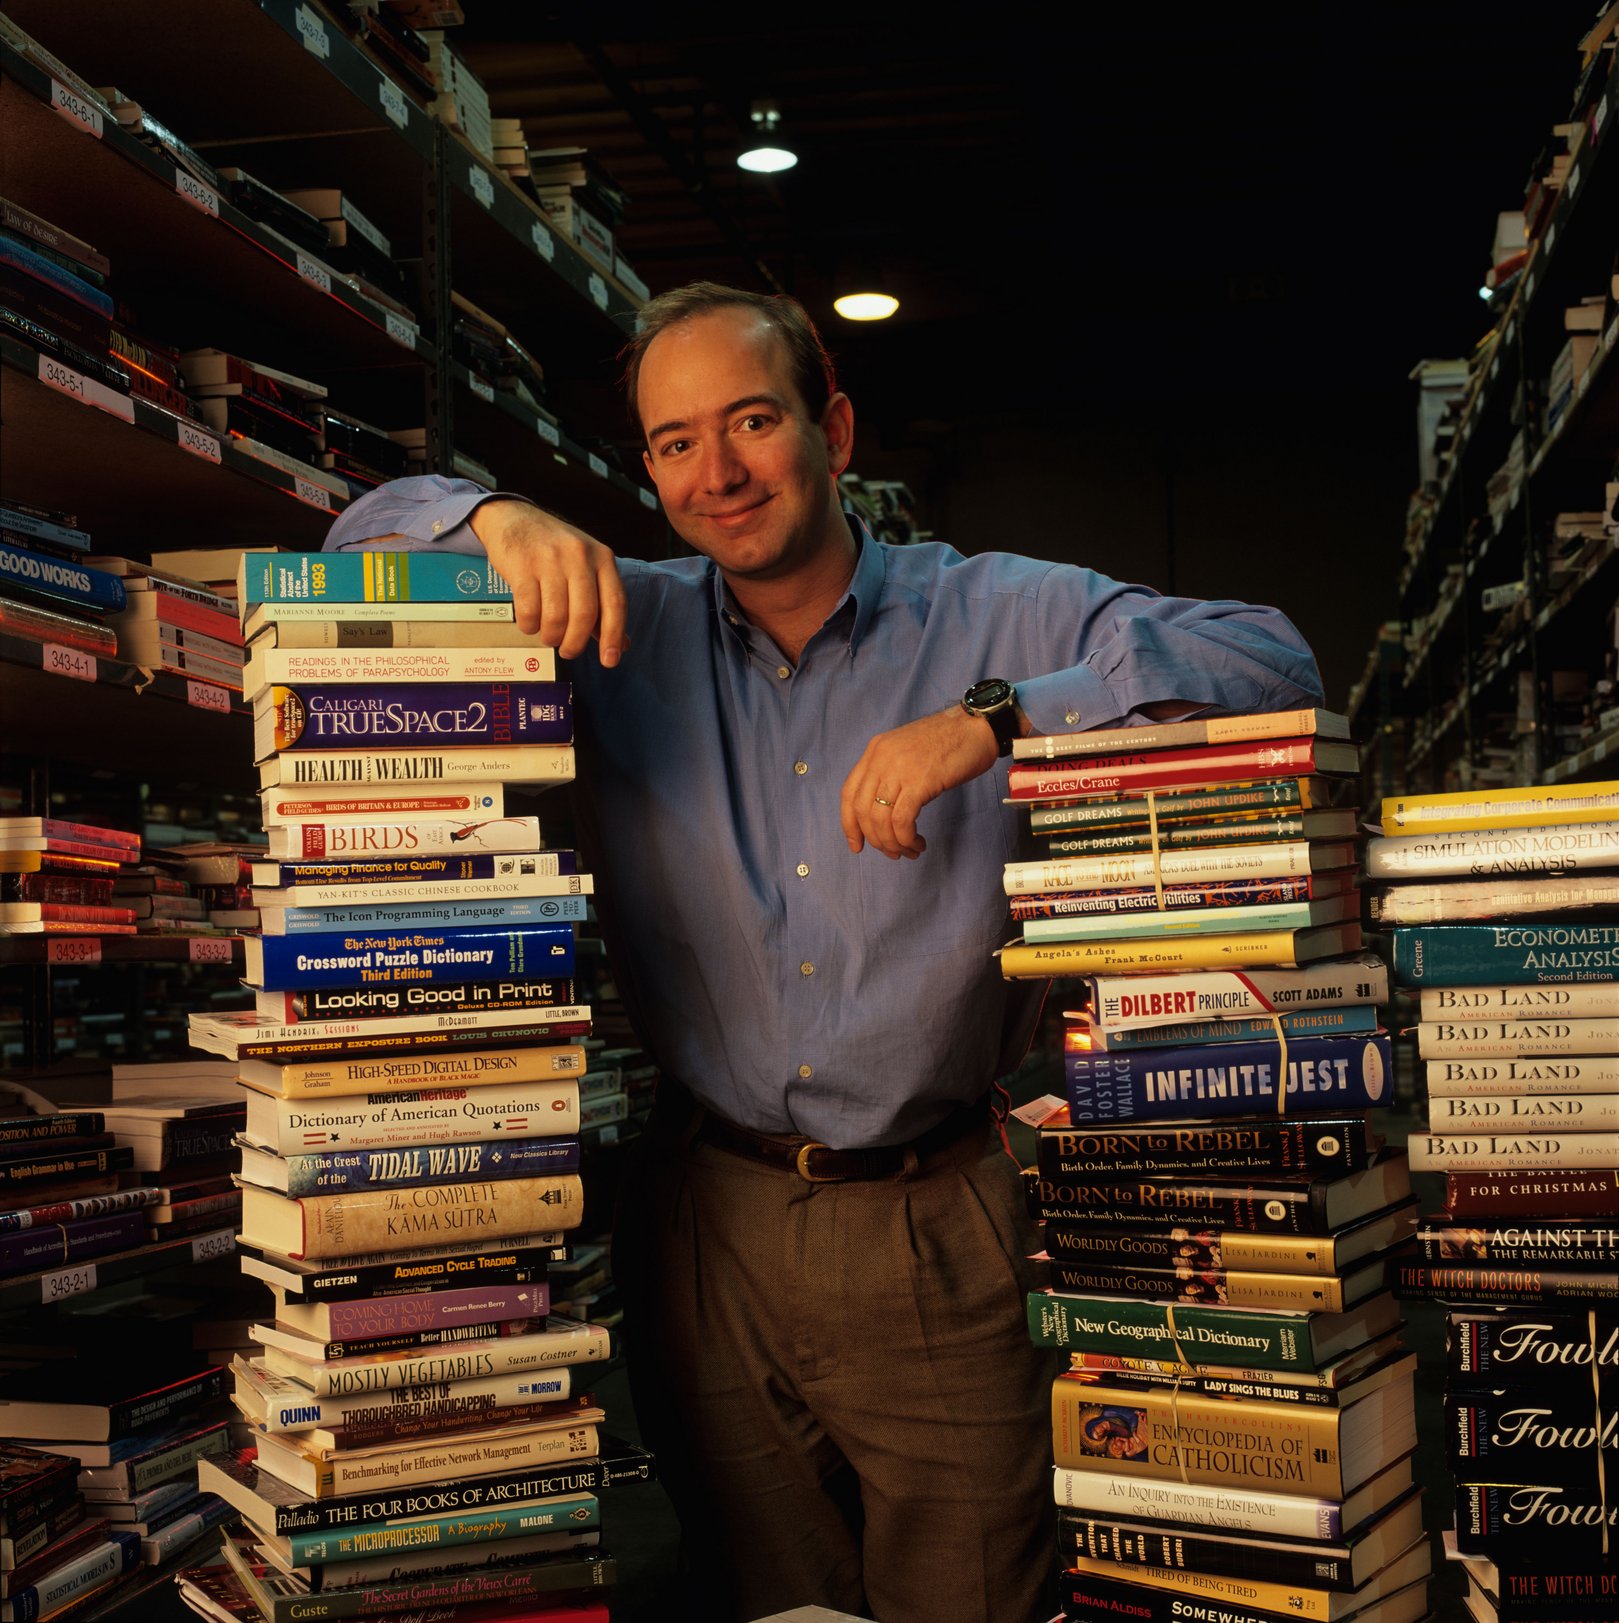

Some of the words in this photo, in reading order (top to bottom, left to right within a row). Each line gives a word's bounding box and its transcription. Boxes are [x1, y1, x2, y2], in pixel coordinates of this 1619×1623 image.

[59, 90, 97, 129] 343-6-1
[182, 177, 214, 210] 343-6-2
[47, 363, 84, 395] 343-5-1
[184, 430, 216, 457] 343-5-2
[40, 562, 91, 592] WORKS
[343, 626, 366, 637] Say's
[370, 626, 388, 636] Law
[52, 651, 90, 676] 343-4-1
[288, 657, 337, 666] READINGS
[341, 657, 350, 666] IN
[354, 657, 372, 666] THE
[375, 656, 450, 666] PHILOSOPHICAL
[288, 668, 342, 678] PROBLEMS
[346, 668, 359, 678] OF
[362, 666, 450, 678] PARAPSYCHOLOGY
[194, 687, 225, 708] 343-4-2
[492, 682, 512, 743] BIBLE
[1037, 776, 1120, 794] Eccles/Crane
[1044, 811, 1074, 824] GOLF
[1078, 807, 1122, 820] DREAMS
[1188, 796, 1220, 810] JOHN
[1224, 792, 1264, 806] UPDIKE
[330, 825, 419, 852] BIRDS
[1061, 840, 1088, 851] GOLF
[1092, 836, 1134, 849] DREAMS
[295, 865, 349, 876] Managing
[350, 863, 392, 874] Finance
[394, 862, 408, 872] for
[410, 860, 447, 872] Quality
[318, 890, 368, 899] YAN-KIT'S
[371, 888, 416, 897] CLASSIC
[418, 886, 461, 896] CHINESE
[464, 884, 519, 894] COOKBOOK
[324, 912, 346, 923] The
[349, 910, 372, 922] Icon
[376, 907, 450, 922] Programming
[453, 906, 505, 920] Language
[56, 943, 93, 961] 343-3-1
[196, 944, 227, 960] 343-3-2
[297, 952, 372, 970] Crossword
[375, 950, 419, 966] Puzzle
[422, 948, 494, 965] Dictionary
[1034, 949, 1080, 959] Angela's
[1085, 948, 1116, 956] Ashes
[1412, 940, 1423, 978] Greene
[361, 970, 390, 982] Third
[394, 968, 433, 980] Edition
[1537, 971, 1574, 982] Second
[1576, 970, 1614, 981] Edition
[315, 992, 400, 1008] Looking
[407, 986, 465, 1004] Good
[473, 985, 491, 1000] in
[499, 983, 552, 999] Print
[1104, 998, 1120, 1018] THE
[1121, 991, 1196, 1018] DILBERT
[1198, 991, 1250, 1010] PRINCIPLE
[1272, 990, 1302, 1002] SCOTT
[1306, 987, 1344, 1000] ADAMS
[1438, 990, 1490, 1008] BAD
[1499, 988, 1570, 1006] LAND
[1460, 1010, 1514, 1018] AMERICAN
[1518, 1009, 1572, 1017] ROMANCE
[247, 1047, 273, 1055] THE
[277, 1042, 342, 1054] NORTHERN
[348, 1038, 411, 1048] EXPOSURE
[415, 1035, 448, 1044] BOOK
[452, 1032, 488, 1040] LOUIS
[492, 1028, 550, 1038] CHUNOVIC
[1436, 1024, 1488, 1041] BAD
[1499, 1023, 1570, 1040] LAND
[304, 1070, 331, 1079] Johnson
[347, 1063, 421, 1080] HIGH-SPEED
[424, 1060, 472, 1074] DIGITAL
[474, 1057, 518, 1070] DESIGN
[1444, 1063, 1498, 1081] BAD
[1508, 1062, 1581, 1080] LAND
[304, 1080, 331, 1088] Graham
[1145, 1064, 1272, 1102] INFINITE
[1286, 1058, 1349, 1094] JEST
[289, 1112, 368, 1129] Dictionary
[371, 1107, 388, 1122] of
[391, 1105, 457, 1122] American
[463, 1100, 540, 1120] Quotations
[1448, 1099, 1501, 1117] BAD
[1511, 1098, 1584, 1116] LAND
[350, 1136, 384, 1146] Margaret
[387, 1134, 410, 1142] Miner
[430, 1131, 450, 1140] Hugh
[1058, 1134, 1142, 1156] BORN
[1147, 1135, 1168, 1150] to
[1175, 1130, 1271, 1152] REBEL
[1425, 1138, 1479, 1155] BAD
[1489, 1136, 1561, 1154] LAND
[368, 1151, 423, 1181] TIDAL
[428, 1146, 482, 1176] WAVE
[1470, 1186, 1501, 1196] FOR
[1510, 1181, 1608, 1195] CHRISTMAS
[200, 1236, 230, 1259] 343-2-2
[1490, 1228, 1586, 1247] AGAINST
[1492, 1249, 1519, 1259] THE
[1522, 1250, 1606, 1260] REMARKABLE
[51, 1274, 90, 1297] 343-2-1
[314, 1276, 358, 1288] GIETZEN
[1400, 1268, 1425, 1287] THE
[1431, 1269, 1474, 1289] WITCH
[1480, 1271, 1542, 1292] DOCTORS
[442, 1304, 468, 1313] Carmen
[468, 1302, 488, 1311] Renee
[488, 1301, 506, 1310] Berry
[1280, 1328, 1289, 1360] Merriam
[1288, 1328, 1297, 1360] Webster
[1460, 1322, 1471, 1372] Burchfield
[328, 1366, 390, 1395] MOSTLY
[398, 1354, 494, 1384] VEGETABLES
[507, 1354, 536, 1366] Susan
[540, 1350, 578, 1362] Costner
[531, 1380, 562, 1394] MORROW
[1204, 1380, 1228, 1392] LADY
[1229, 1383, 1254, 1395] SINGS
[1255, 1386, 1272, 1398] THE
[1272, 1388, 1300, 1400] BLUES
[280, 1406, 322, 1426] QUINN
[1458, 1408, 1469, 1456] Burchfield
[1152, 1444, 1306, 1482] CATHOLICISM
[278, 1510, 320, 1529] Palladio
[326, 1506, 358, 1524] THE
[363, 1500, 403, 1518] FOUR
[406, 1492, 459, 1512] BOOKS
[462, 1488, 482, 1504] OF
[486, 1473, 596, 1500] ARCHITECTURE
[1470, 1486, 1480, 1535] Burchfield
[1320, 1508, 1332, 1540] EVANS
[1509, 1576, 1538, 1596] THE
[1546, 1575, 1594, 1596] WITCH
[1072, 1592, 1108, 1610] BRIAN
[1110, 1600, 1152, 1618] ALDISS
